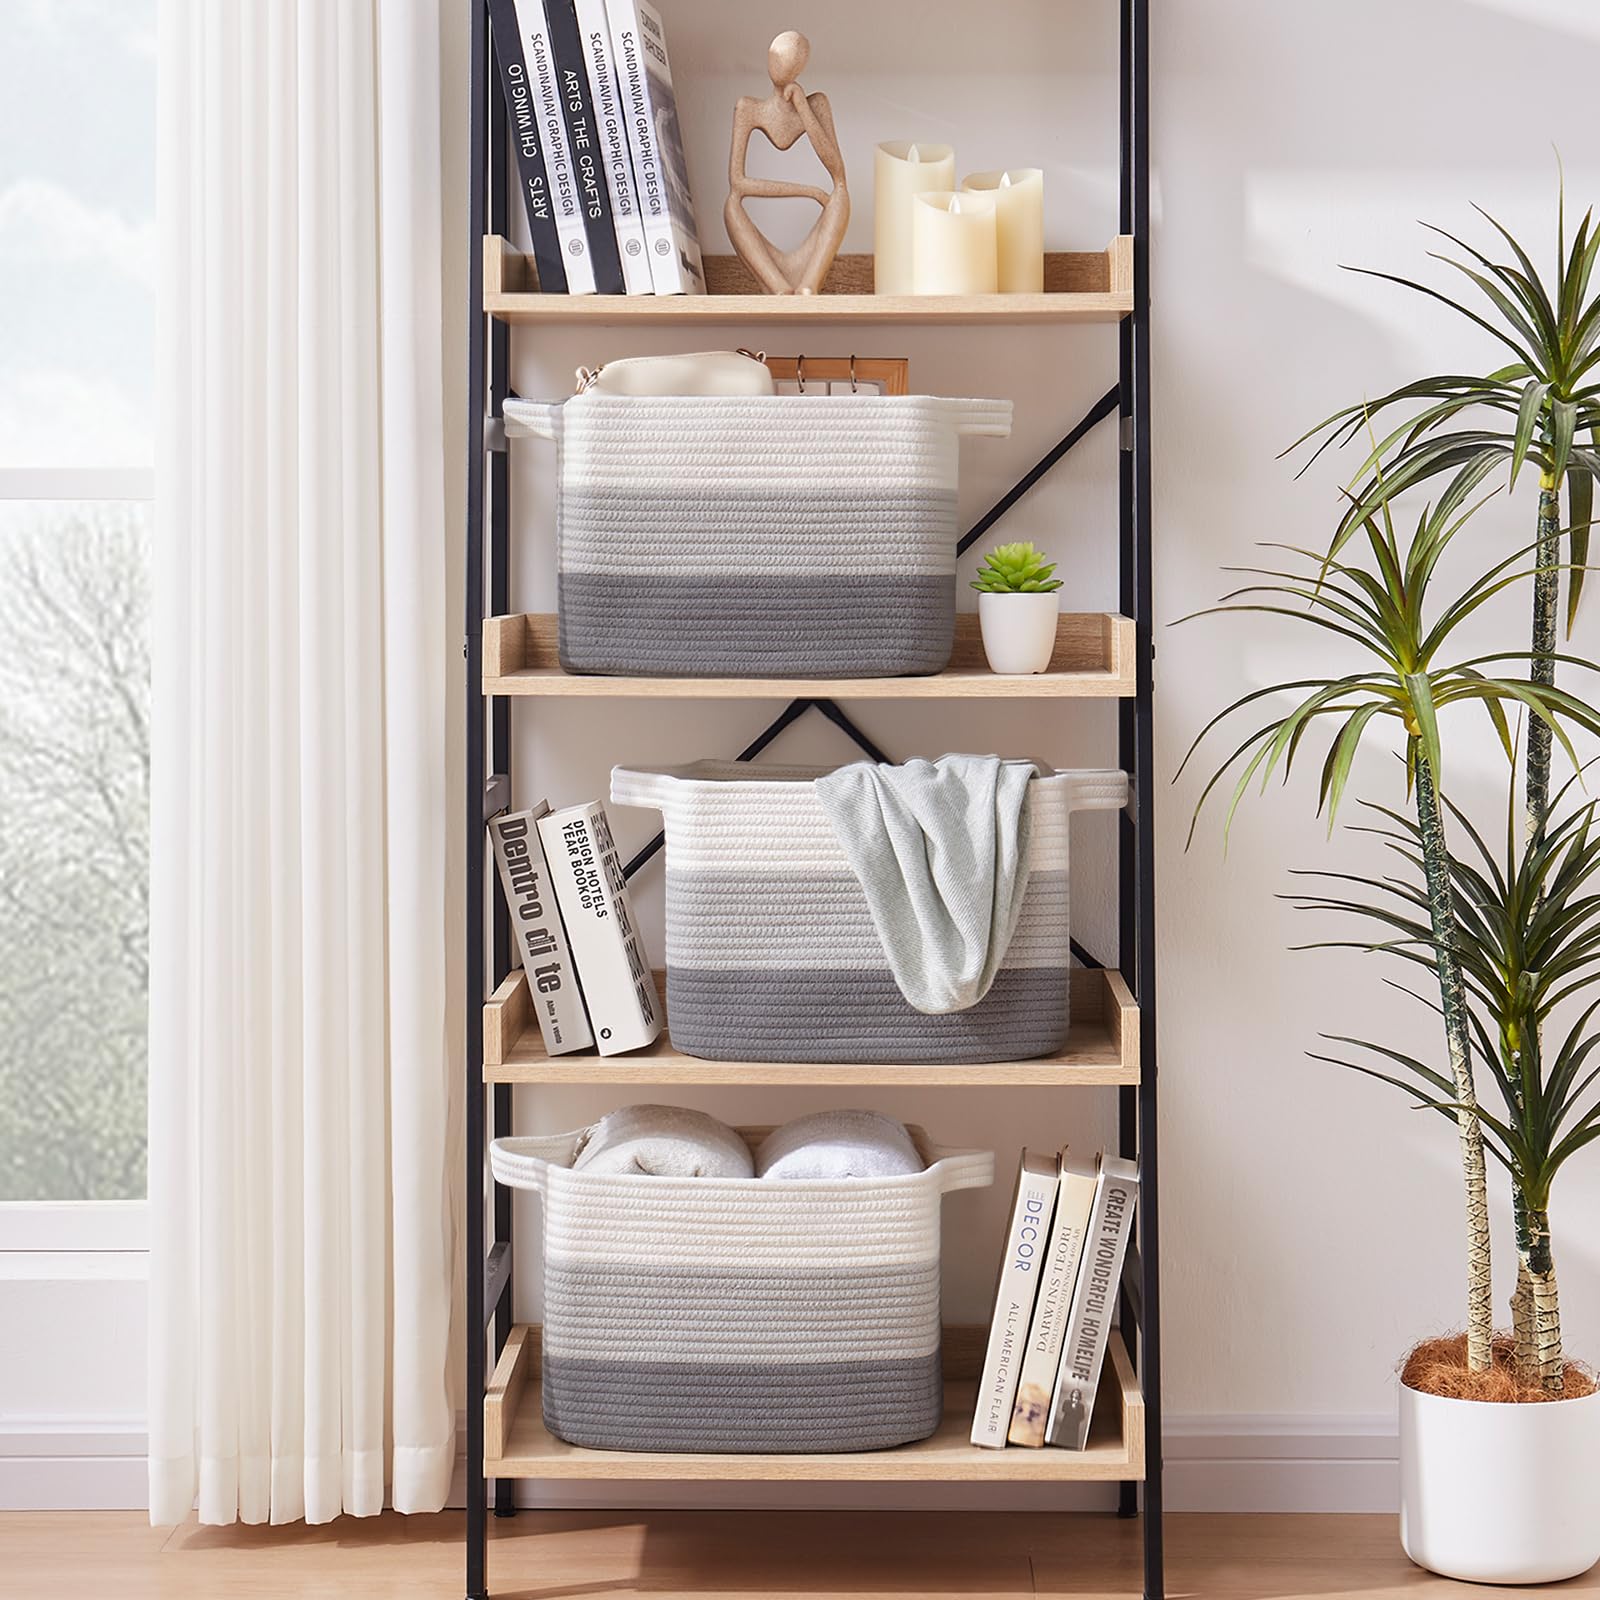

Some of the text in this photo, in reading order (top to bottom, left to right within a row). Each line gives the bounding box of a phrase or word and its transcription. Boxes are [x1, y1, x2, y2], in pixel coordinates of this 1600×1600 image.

[531, 33, 574, 216] SCANDINAVIAV GRAPHIC DESIGN
[564, 70, 602, 218] ARTS THE CRAFTS
[590, 32, 632, 216] SCANDINAVIAV GRAPHIC DESIGN
[621, 32, 661, 215] SCANDINAVIAV GRAPHIC DESIGN
[529, 177, 548, 218] ARTS
[497, 818, 561, 993] Dentro di te
[562, 823, 579, 856] YEAR
[573, 820, 608, 918] DESIGN HOTELS
[1014, 1200, 1043, 1271] DECOR
[1036, 1226, 1072, 1352] DARWINS TEORI
[1072, 1188, 1127, 1382] CREATE WONDERFUL HOMELIFE
[988, 1302, 1020, 1432] ALL-AMERICAN FLAIR
